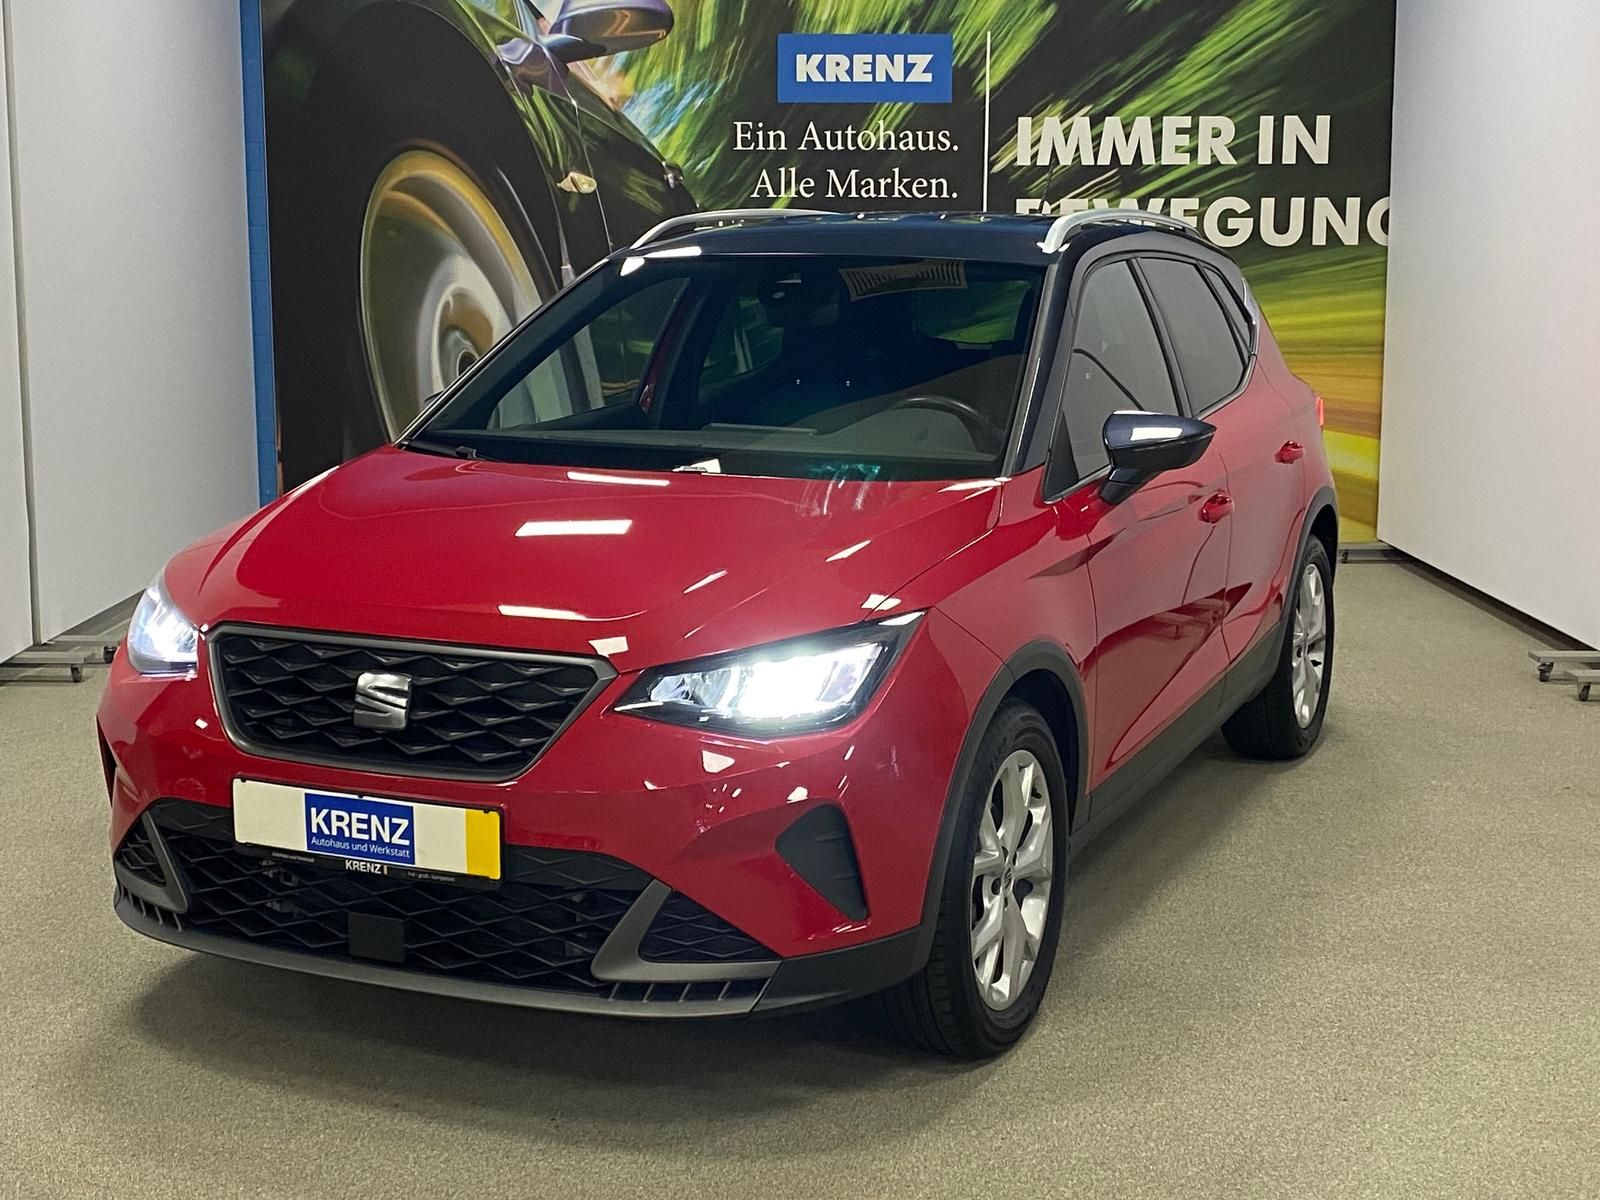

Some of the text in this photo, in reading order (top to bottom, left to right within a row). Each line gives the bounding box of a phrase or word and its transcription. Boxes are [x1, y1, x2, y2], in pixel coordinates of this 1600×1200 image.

[795, 53, 934, 83] KRENZ
[733, 120, 960, 153] Ein Autohaus.
[1016, 115, 1331, 166] IMMER IN
[750, 168, 959, 200] Alle Marken.
[310, 807, 410, 846] KRENZ
[311, 836, 410, 858] Autohaus und Werkstatt
[345, 860, 381, 874] KRENZ
